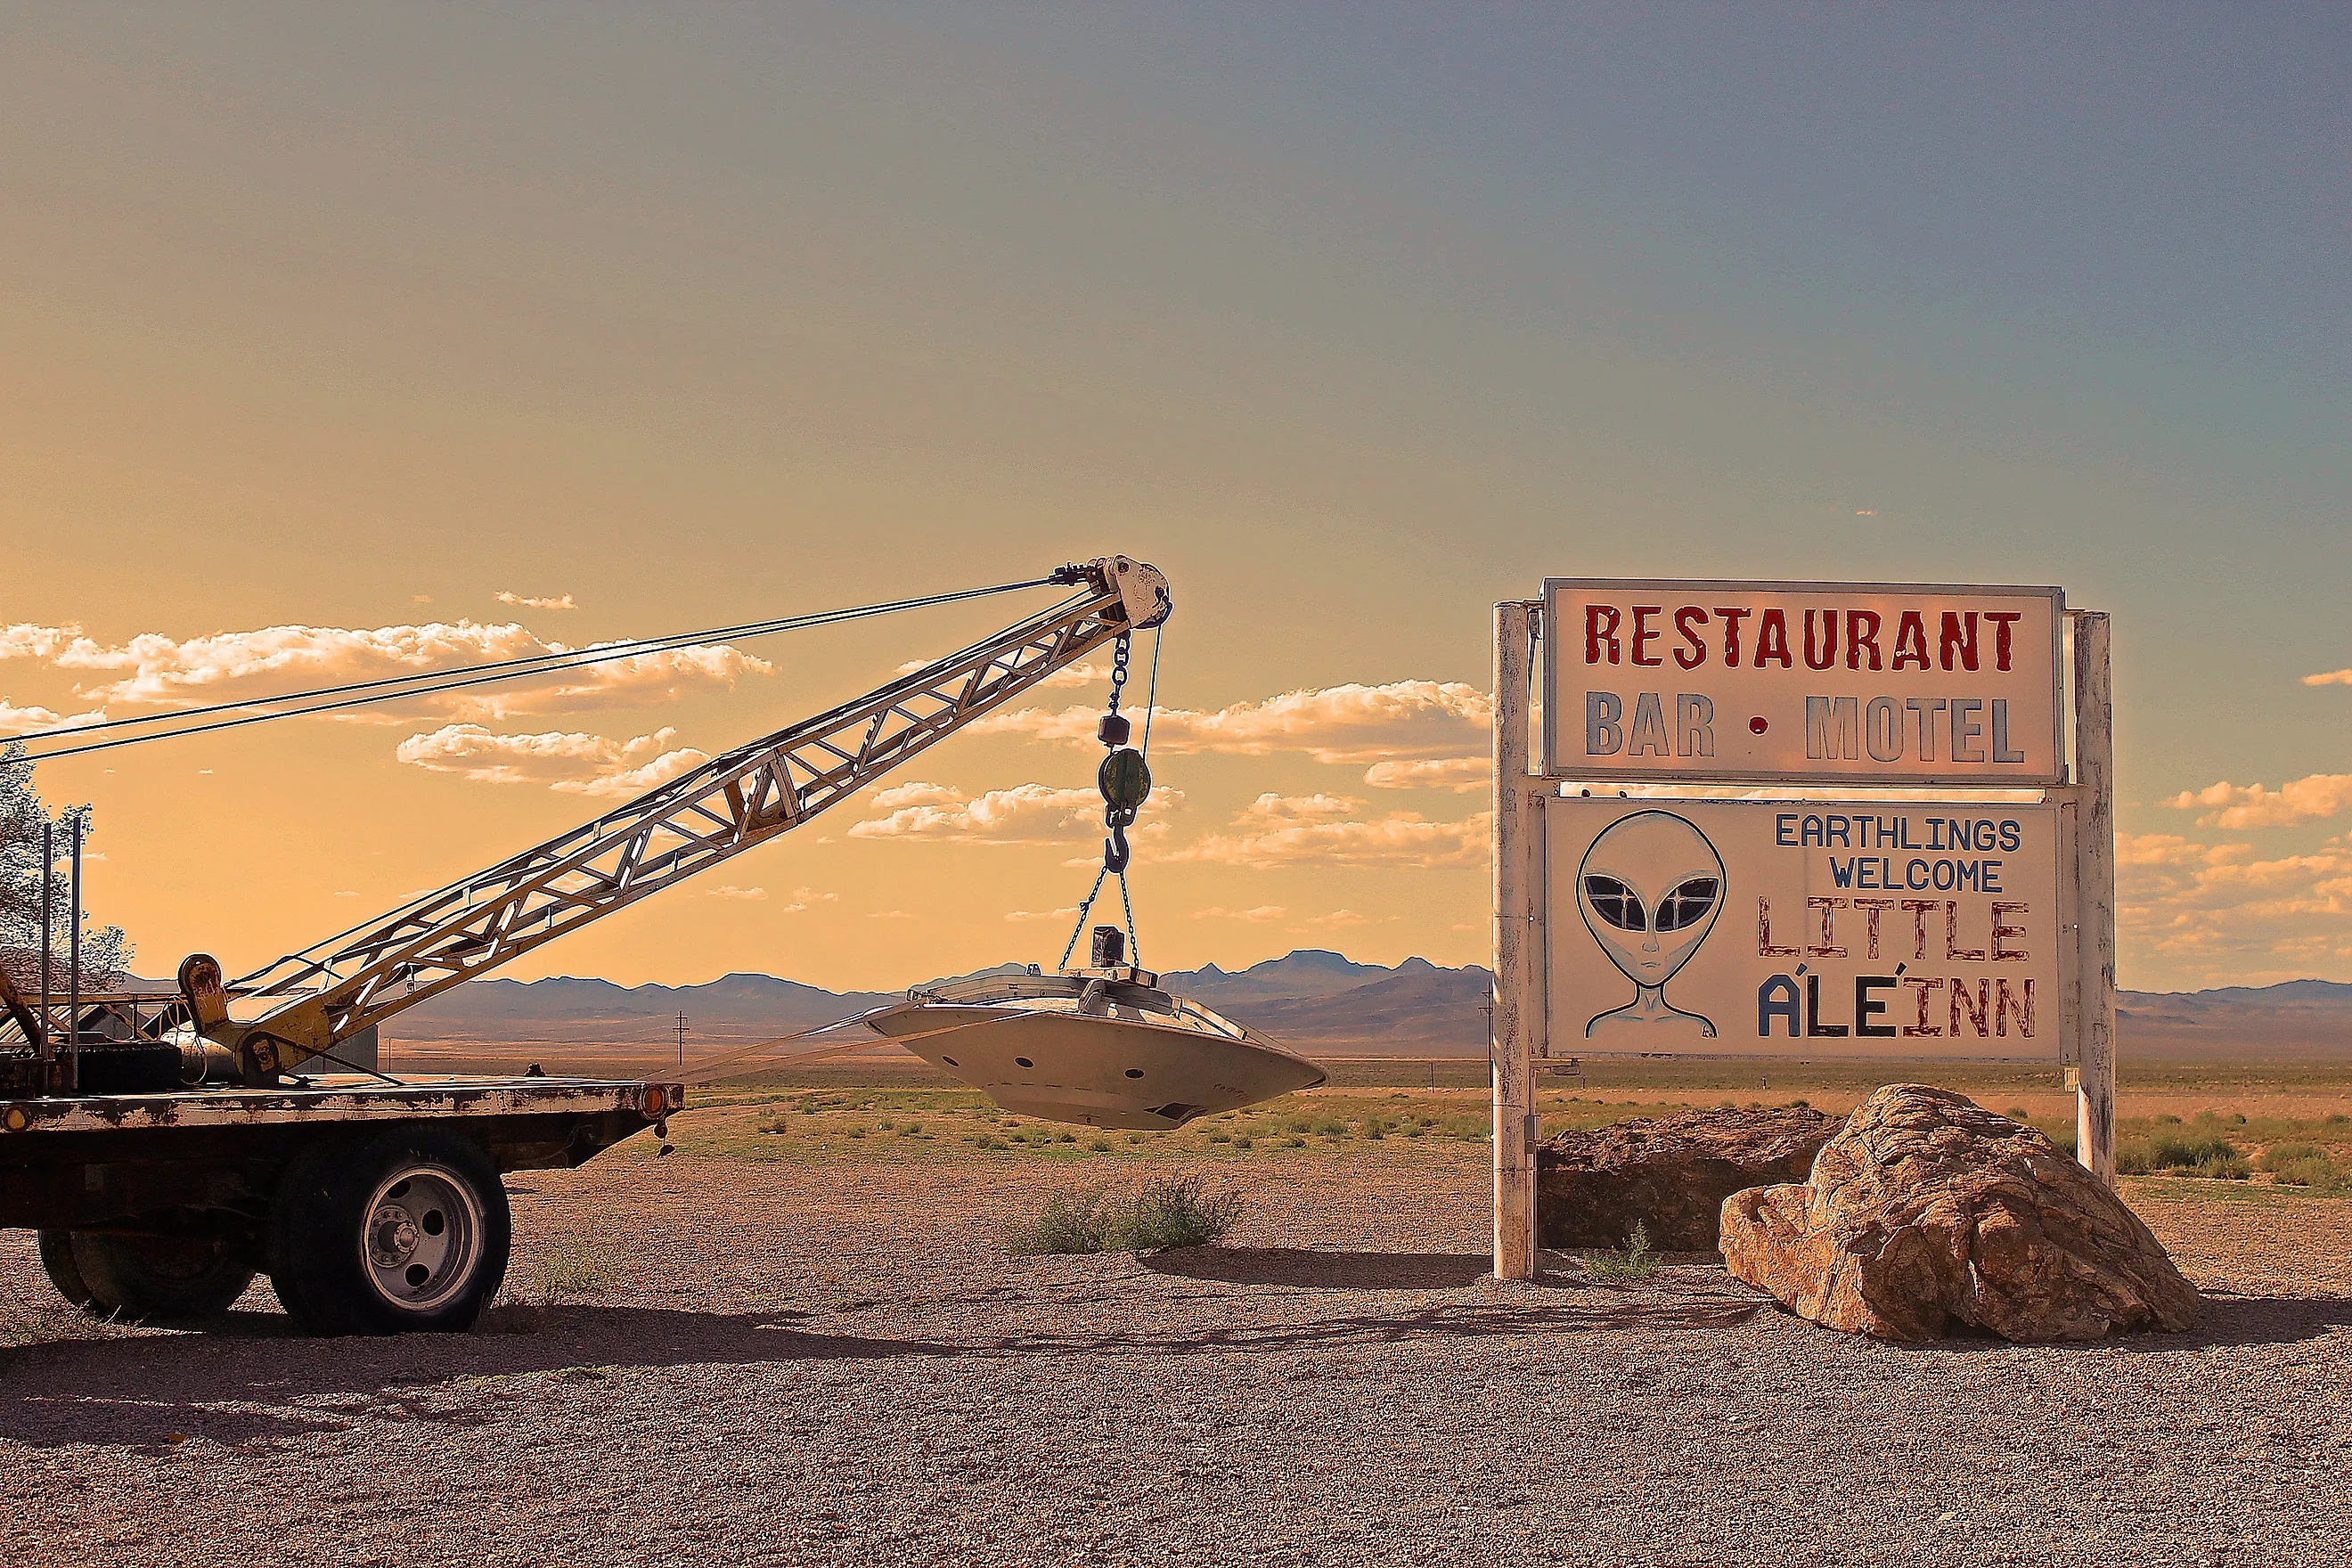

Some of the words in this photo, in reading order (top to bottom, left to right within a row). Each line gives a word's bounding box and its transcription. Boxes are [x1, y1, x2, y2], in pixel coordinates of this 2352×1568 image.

[1585, 605, 2021, 671] RESTAURANT
[1585, 691, 1715, 757] BAR
[1806, 697, 2025, 764] MOTEL
[1776, 814, 2021, 852] EARTHLINGS
[1829, 856, 2003, 894] WELCOME
[1759, 897, 2029, 961] LITTLE
